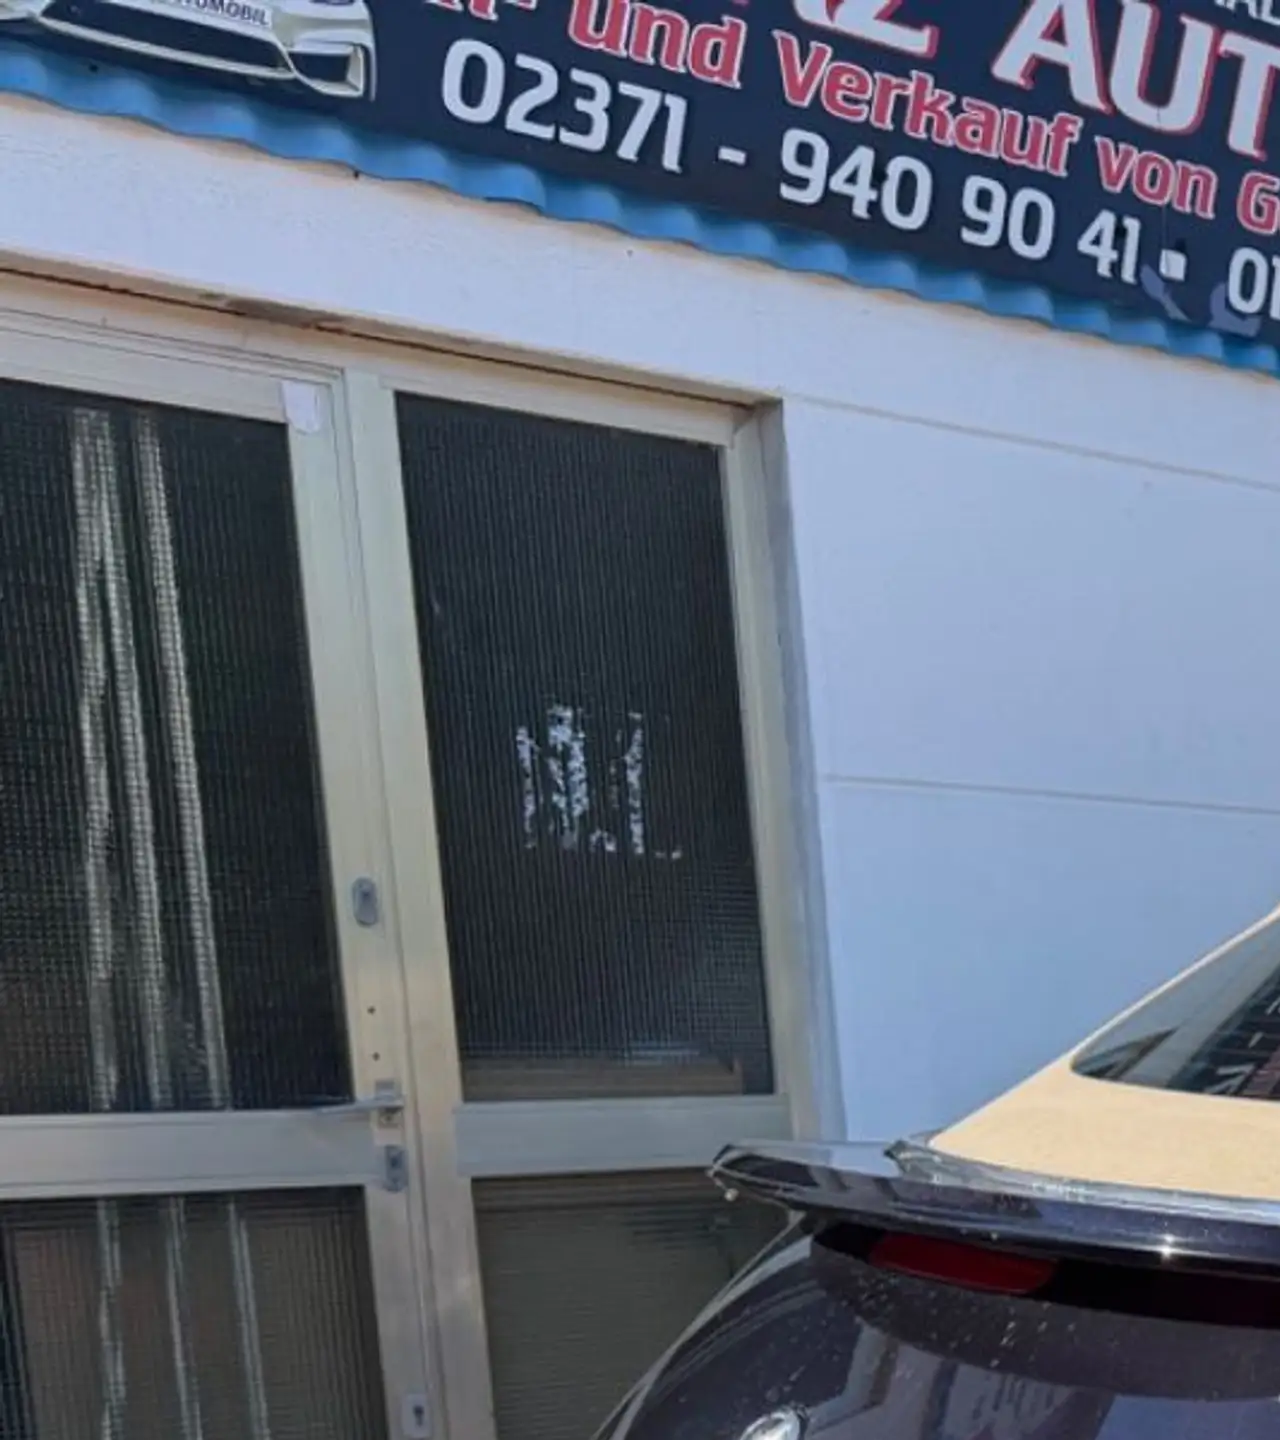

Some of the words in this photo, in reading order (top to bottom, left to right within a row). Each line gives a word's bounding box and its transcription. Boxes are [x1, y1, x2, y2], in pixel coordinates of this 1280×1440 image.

[441, 39, 687, 173] 02371
[779, 128, 933, 232] 940
[960, 174, 1056, 261] 90
[1076, 208, 1142, 285] 41
[567, 0, 743, 88] und
[773, 29, 1083, 178] Verkauf
[1095, 135, 1216, 219] von
